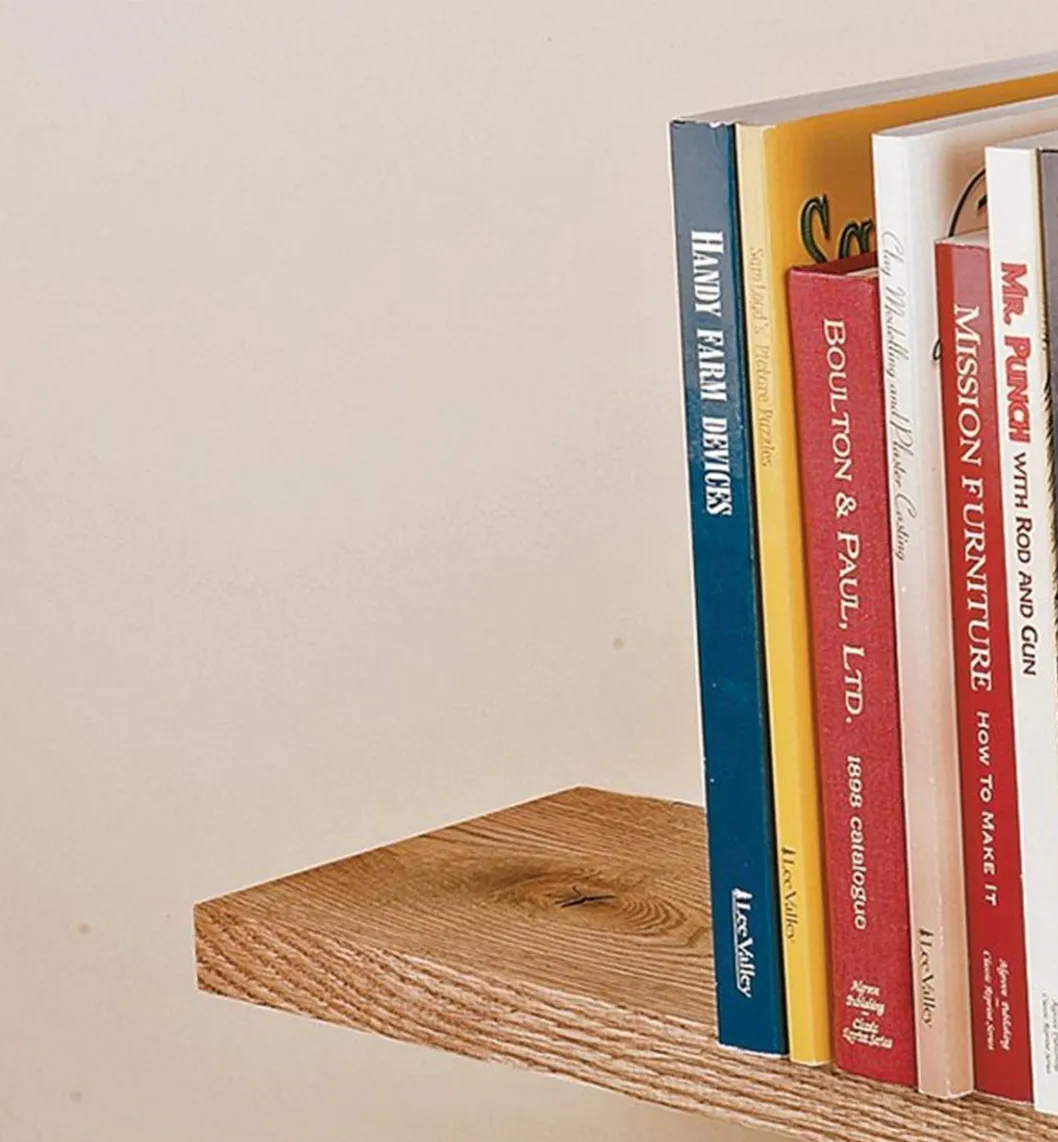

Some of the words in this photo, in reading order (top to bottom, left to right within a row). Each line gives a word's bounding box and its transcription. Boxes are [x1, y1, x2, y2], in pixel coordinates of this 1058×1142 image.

[691, 230, 723, 317] HANDY
[882, 230, 906, 277] Clay
[1000, 262, 1029, 326] MR.
[883, 285, 912, 379] Modelling
[697, 329, 728, 401] FARM
[755, 344, 772, 403] Picture
[953, 303, 983, 466] MISSION
[1004, 336, 1032, 444] PUNCH
[823, 318, 853, 482] BOULTON
[702, 416, 733, 516] DEVICES
[758, 408, 775, 468] Puzzles
[836, 492, 857, 518] &
[1012, 451, 1032, 509] WITH
[1015, 517, 1032, 564] ROD
[837, 530, 860, 630] PAUL,
[961, 476, 992, 692] FURNITURE
[1017, 571, 1033, 619] AND
[1020, 625, 1038, 676] GUN
[842, 643, 865, 723] LTD.
[976, 711, 991, 766] HOW
[978, 774, 993, 802] TO
[849, 816, 867, 929] catalogue
[980, 811, 997, 876] MAKE
[984, 883, 998, 906] IT
